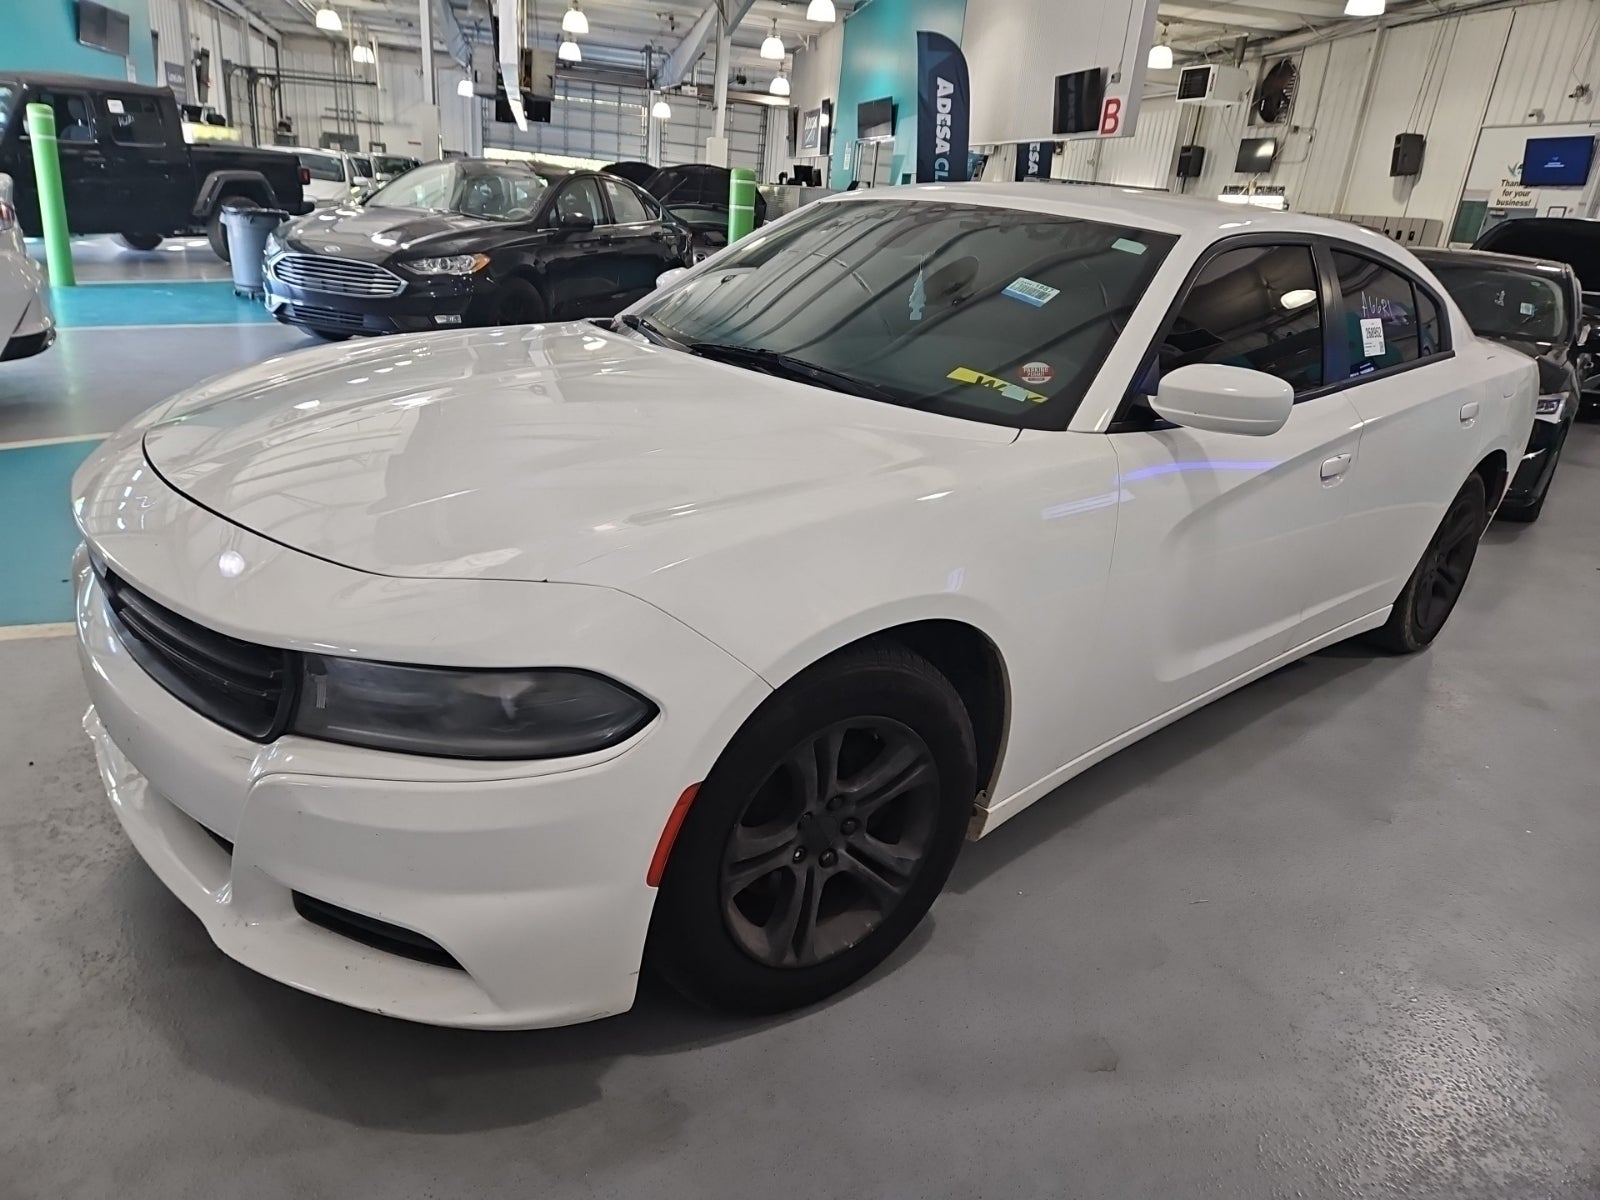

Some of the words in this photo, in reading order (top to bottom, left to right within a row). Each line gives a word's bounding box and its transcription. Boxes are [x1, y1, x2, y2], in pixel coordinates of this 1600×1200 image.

[936, 77, 954, 155] ADESA
[1101, 98, 1121, 134] B
[1501, 180, 1522, 188] Than
[1496, 199, 1532, 207] business!
